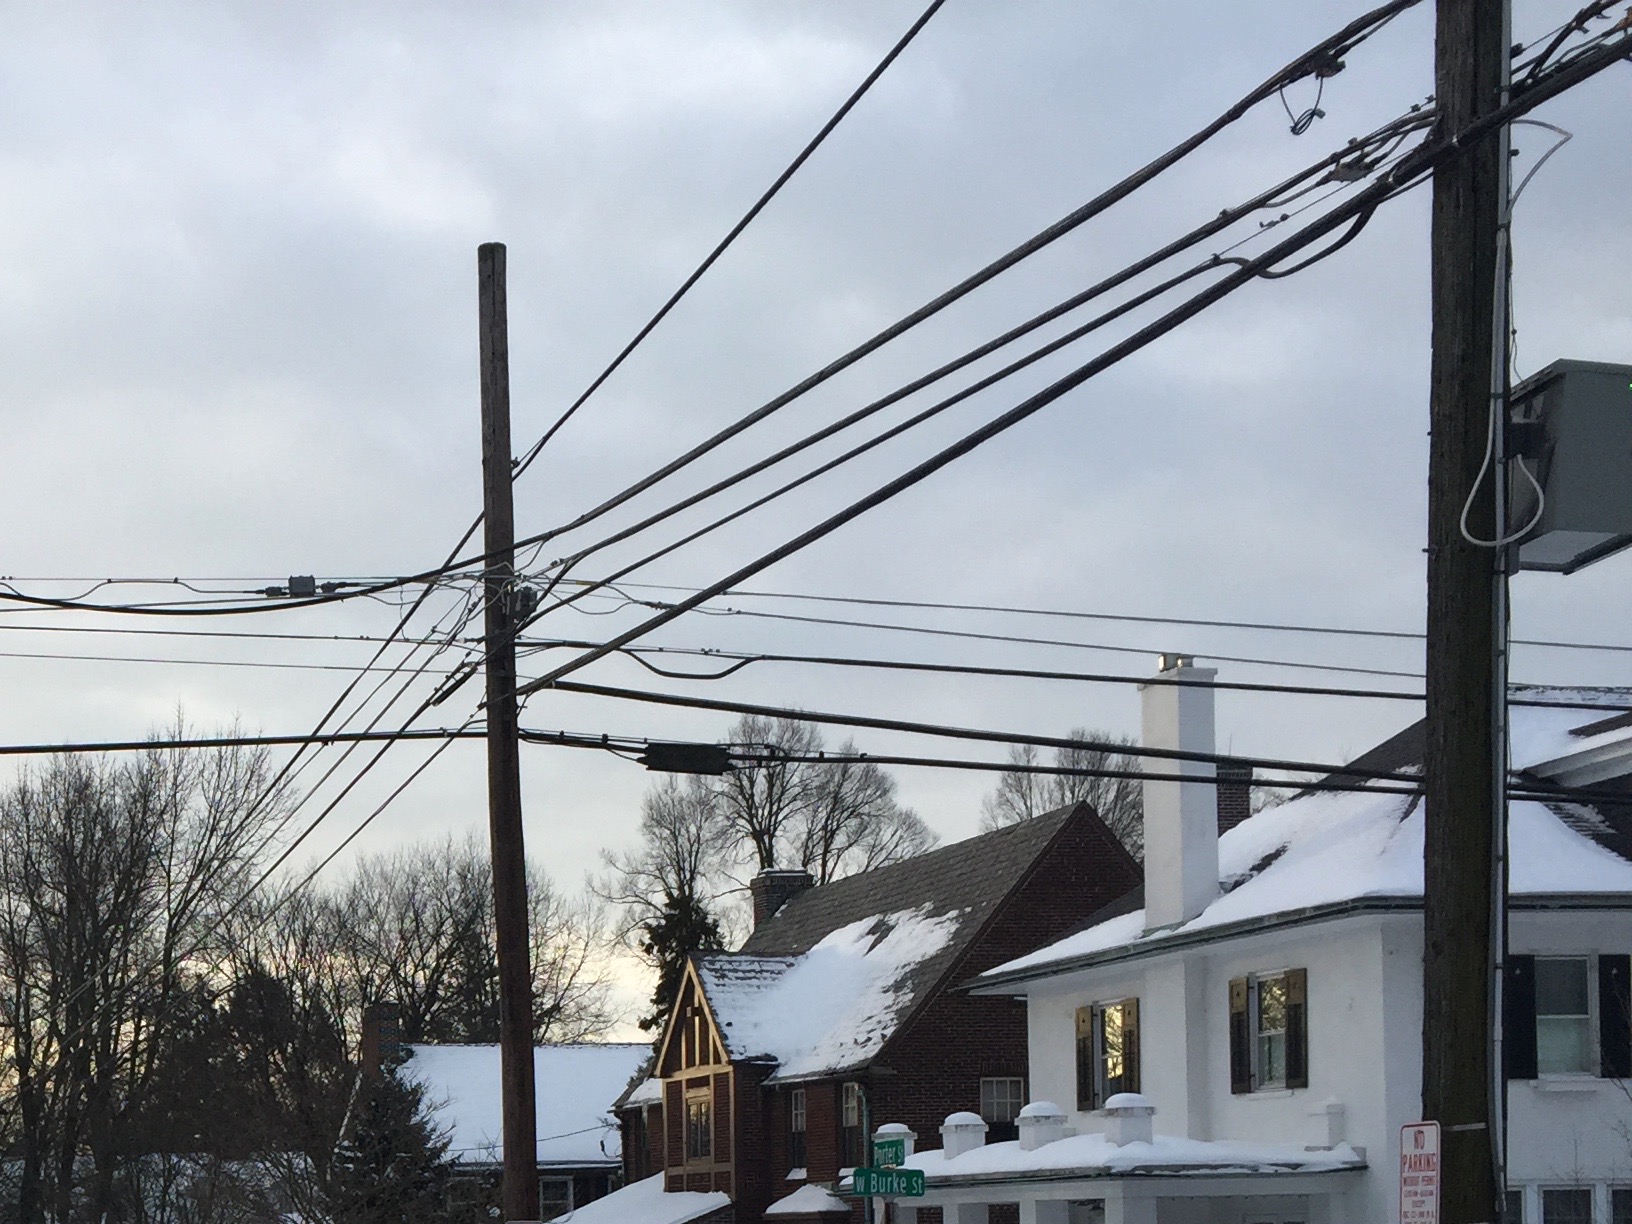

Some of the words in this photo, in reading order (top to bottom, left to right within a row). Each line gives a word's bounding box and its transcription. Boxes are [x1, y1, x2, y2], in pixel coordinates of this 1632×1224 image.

[1413, 1129, 1425, 1150] NO
[874, 1145, 896, 1166] Porter
[1402, 1152, 1437, 1173] PARKING
[870, 1172, 907, 1194] Burke
[911, 1175, 923, 1194] St
